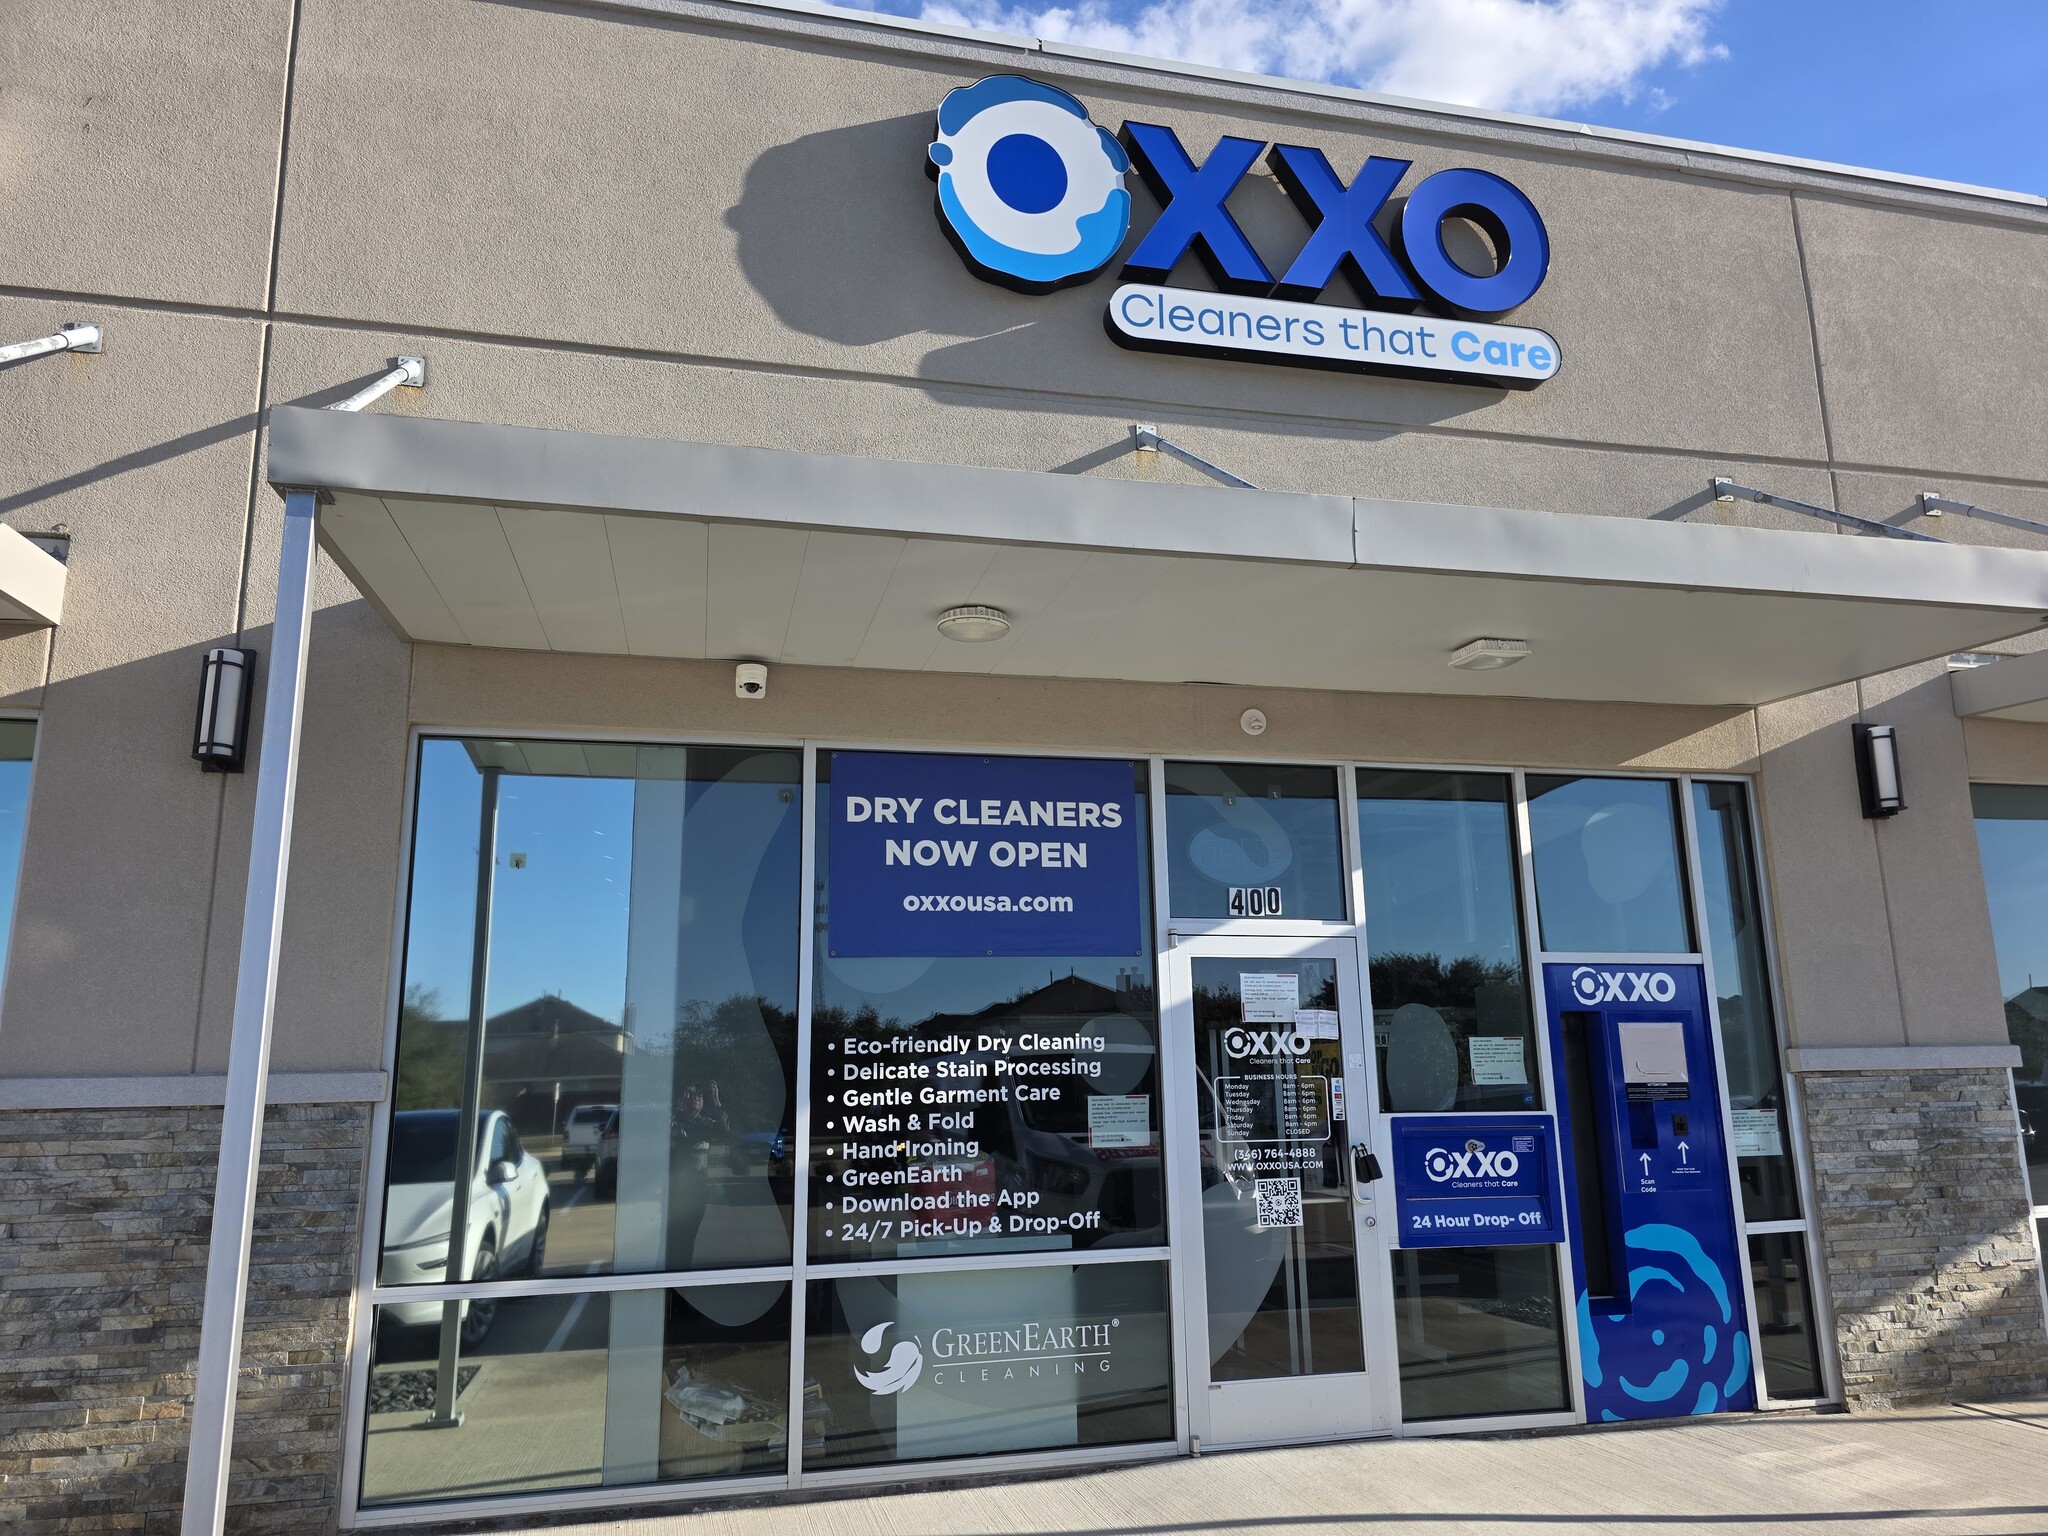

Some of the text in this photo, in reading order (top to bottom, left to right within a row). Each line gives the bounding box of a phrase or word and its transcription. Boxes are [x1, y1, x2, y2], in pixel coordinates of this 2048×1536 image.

[928, 74, 1550, 313] OXXO
[1121, 293, 1551, 372] Cleaners that Care
[846, 796, 1122, 828] DRY CLEANERS
[885, 839, 1087, 868] NOW OPEN
[903, 894, 1073, 912] oxxousa.com
[1231, 888, 1280, 915] 400
[1571, 966, 1676, 1005] OXXO
[844, 1033, 1105, 1055] Eco-friendly Dry Cleaning
[1224, 1027, 1311, 1059] OXXO
[844, 1059, 1101, 1081] Delicate Stain Processing
[1249, 1057, 1278, 1065] Cleaners
[1279, 1057, 1294, 1065] that
[843, 1085, 1061, 1106] Gentle Garment Care
[843, 1112, 974, 1133] Wash & Fold
[843, 1140, 979, 1159] Hand Ironing
[1234, 1148, 1316, 1161] (346) 764-4888
[842, 1166, 962, 1186] GreenEarth
[1228, 1160, 1324, 1171] WWW.OXXOUSA.COM
[1425, 1148, 1518, 1182] OXXO
[843, 1189, 1040, 1213] Download the App
[842, 1211, 1100, 1242] 24/7 Pick-Up & Drop-Off
[1412, 1212, 1541, 1228] 24 Hour Drop- Off
[935, 1360, 1110, 1385] CLEANING
